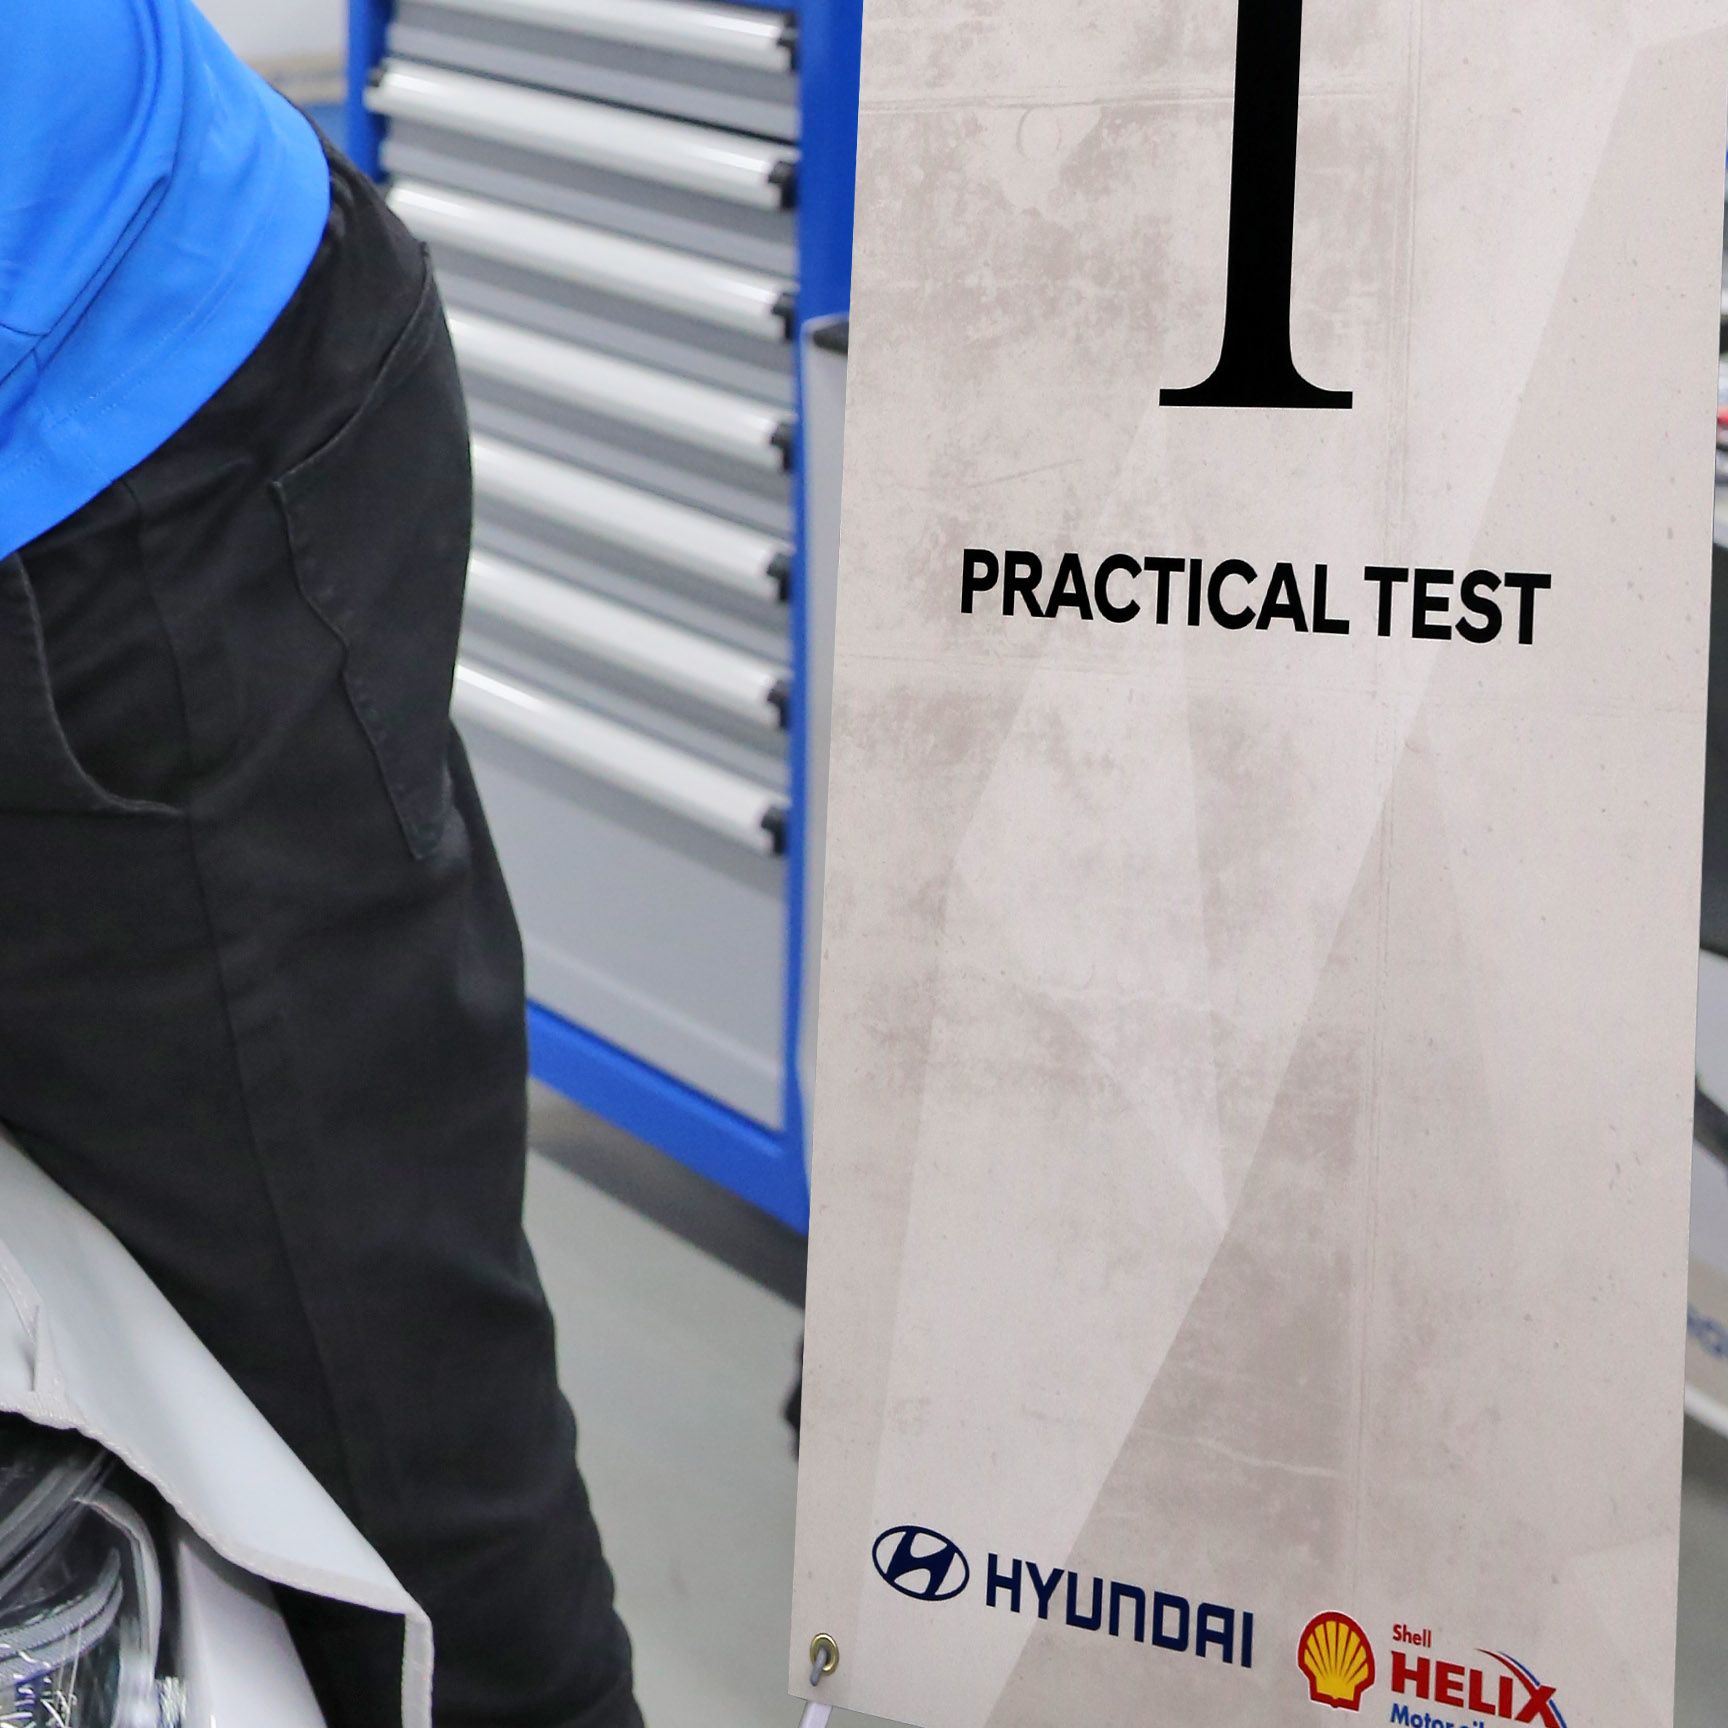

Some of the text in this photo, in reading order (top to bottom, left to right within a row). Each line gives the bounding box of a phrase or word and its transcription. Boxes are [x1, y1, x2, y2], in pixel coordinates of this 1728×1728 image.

[960, 548, 1552, 645] PRACTICAL TEST
[985, 1552, 1254, 1669] HYUNDAI
[1392, 1623, 1432, 1648] Shell
[1390, 1648, 1568, 1728] HELIX
